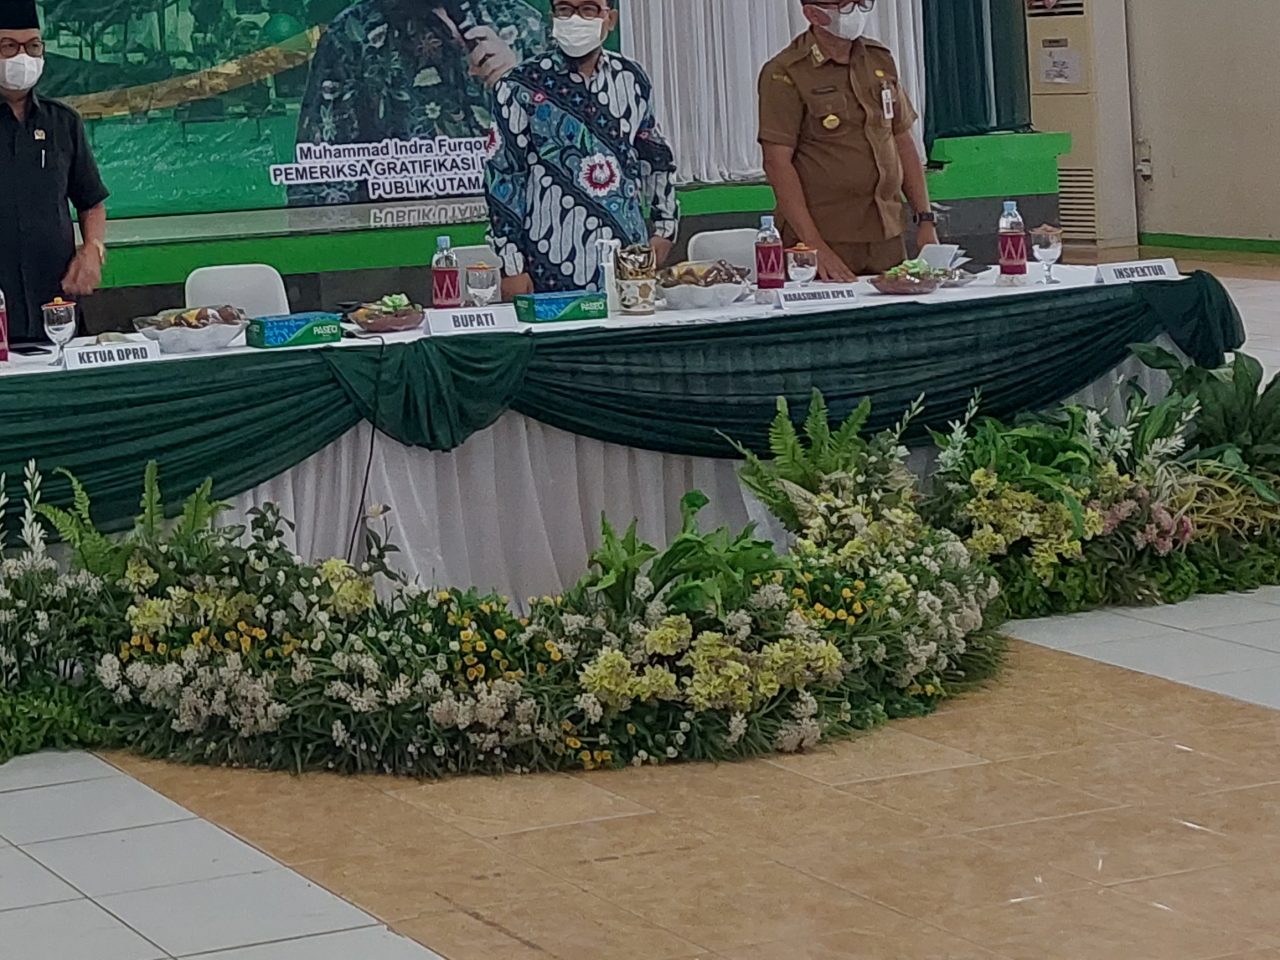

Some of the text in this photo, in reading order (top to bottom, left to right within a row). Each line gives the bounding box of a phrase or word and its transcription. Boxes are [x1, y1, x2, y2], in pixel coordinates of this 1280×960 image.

[299, 143, 389, 161] Muhammad
[395, 140, 433, 157] Indra
[273, 163, 370, 182] PEMERIKSA
[375, 157, 476, 176] GRATIFIKASI
[371, 178, 434, 197] PUBLIK
[1113, 265, 1166, 279] INSPEKTUR
[452, 313, 495, 328] BUPATI
[313, 325, 338, 334] PASEO
[78, 347, 148, 364] KETUA DPRD
